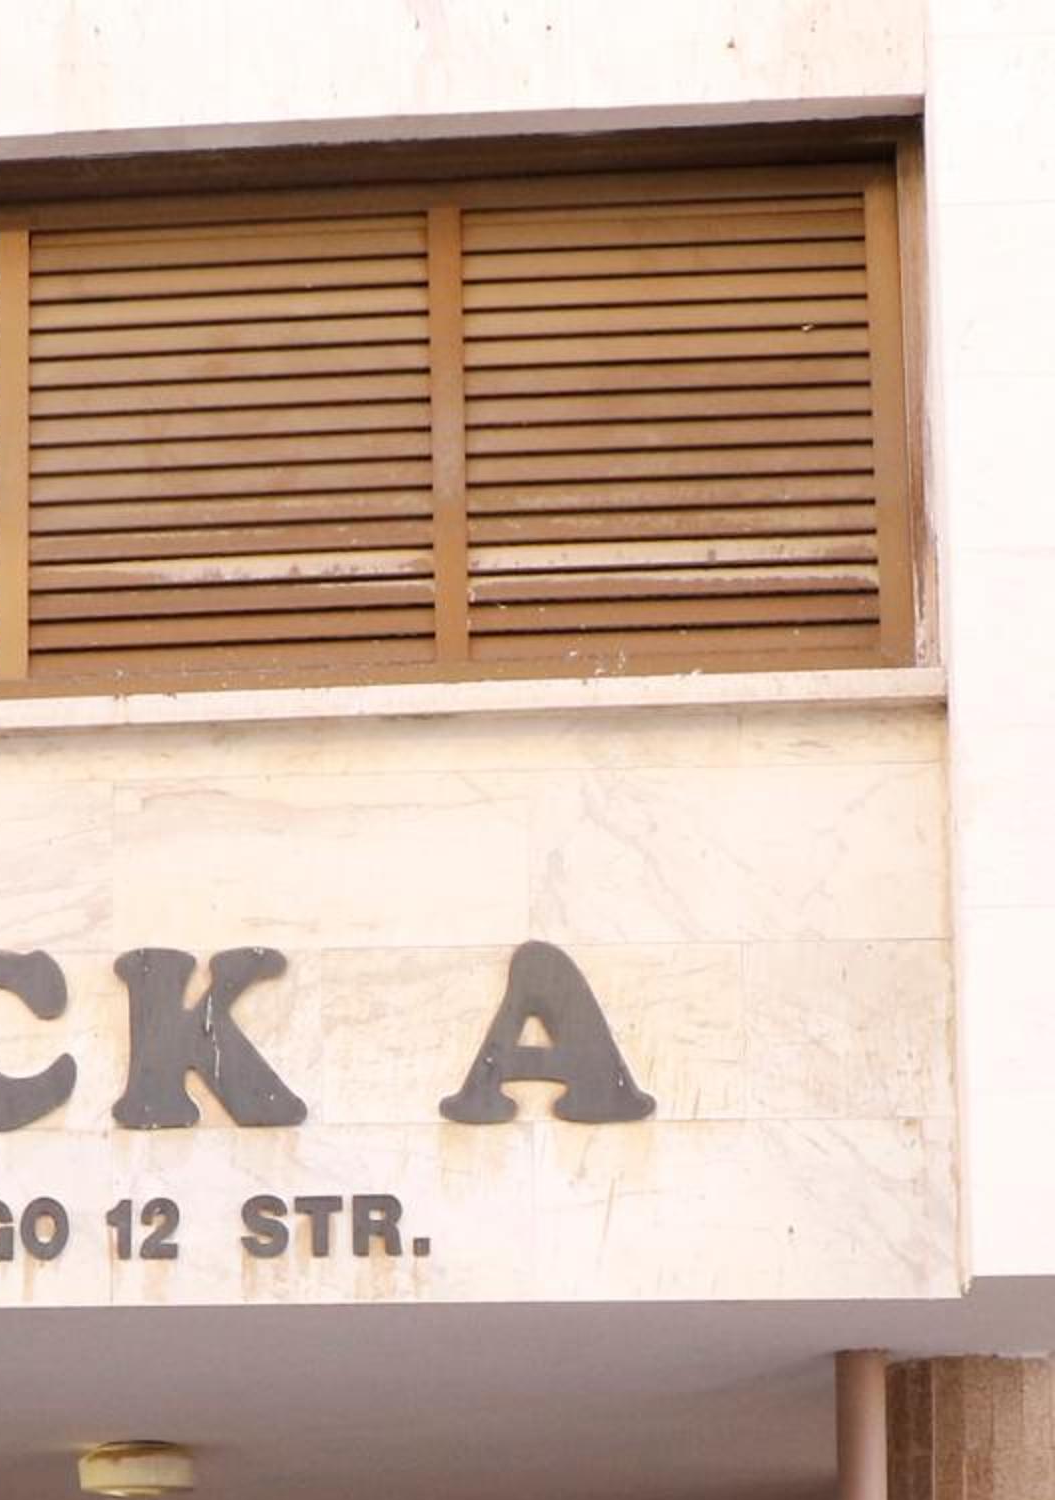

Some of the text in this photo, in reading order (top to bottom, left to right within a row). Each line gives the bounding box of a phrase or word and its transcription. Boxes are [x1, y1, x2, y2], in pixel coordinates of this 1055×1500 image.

[438, 940, 657, 1125] A
[106, 1197, 180, 1260] 12
[240, 1194, 431, 1258] STR.
